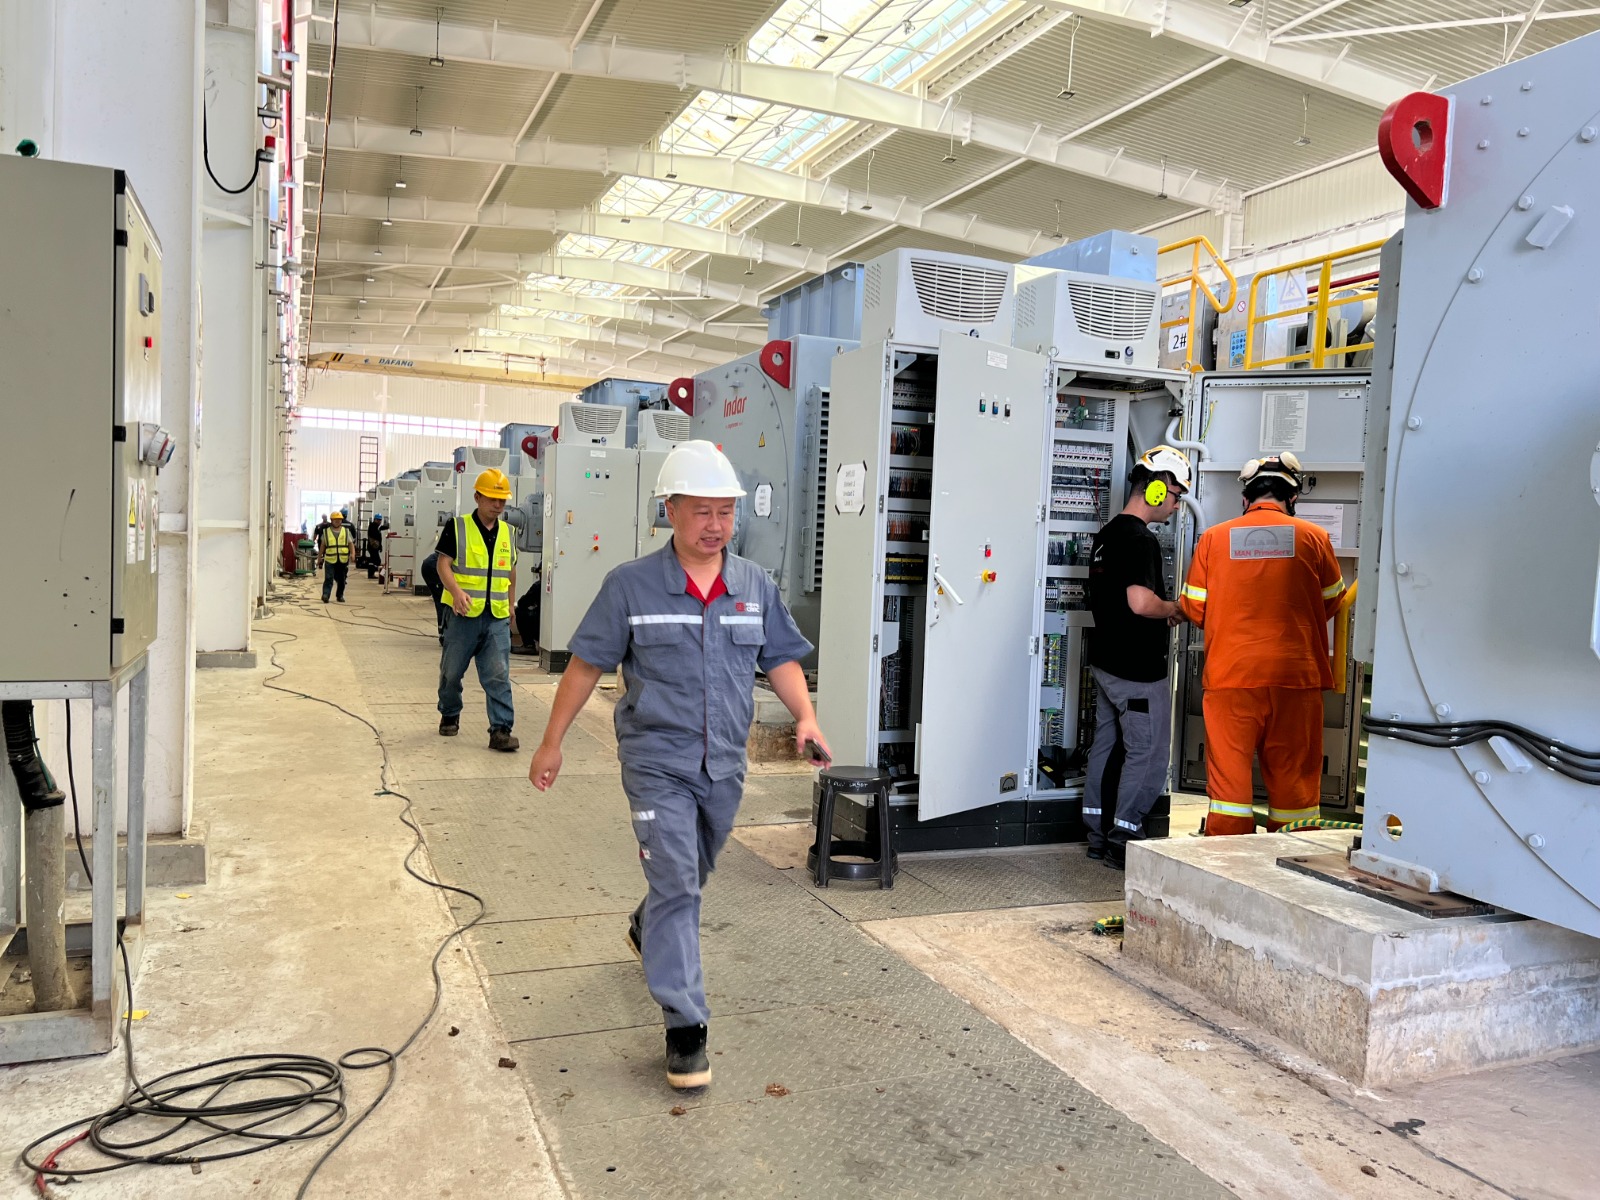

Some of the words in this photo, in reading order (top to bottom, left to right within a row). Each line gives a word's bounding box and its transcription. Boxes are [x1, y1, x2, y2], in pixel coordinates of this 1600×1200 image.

[1173, 332, 1187, 350] 2#
[379, 358, 414, 366] DAFANG
[724, 396, 747, 417] Indar
[1234, 549, 1252, 557] MAN
